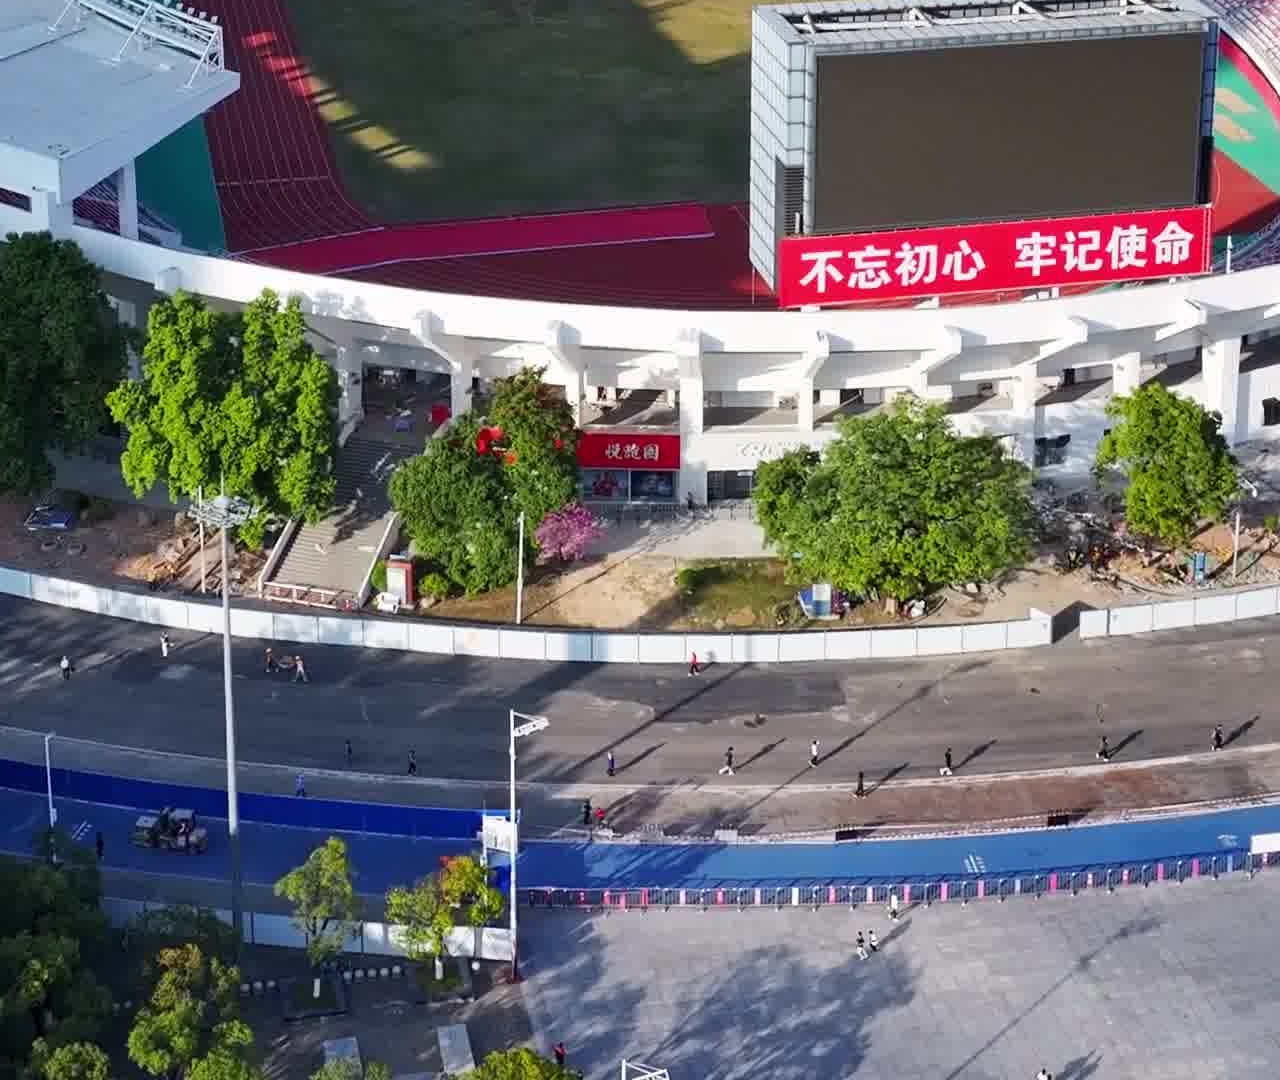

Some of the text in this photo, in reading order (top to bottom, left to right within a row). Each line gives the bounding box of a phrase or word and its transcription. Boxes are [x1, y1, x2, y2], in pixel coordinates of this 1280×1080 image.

[799, 221, 1194, 293] 不忘初心 牢记使命
